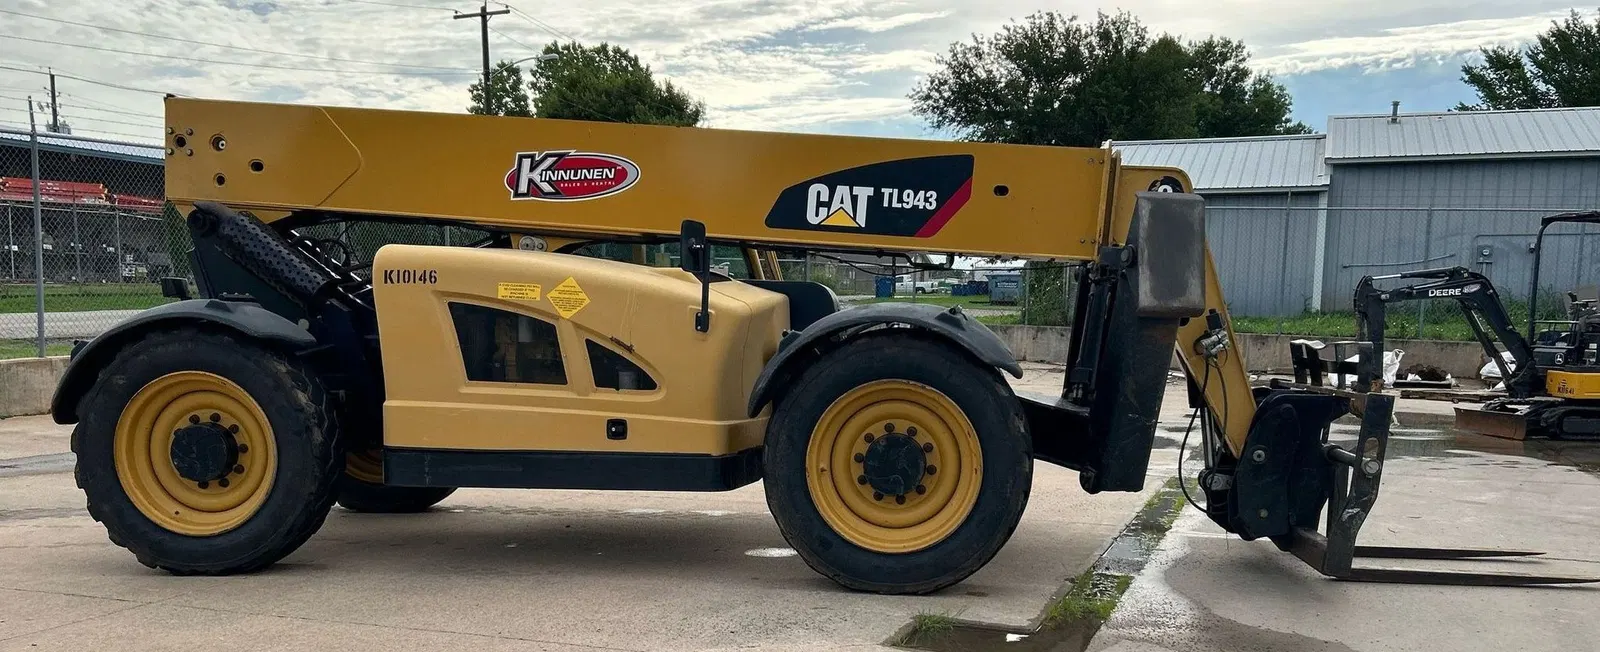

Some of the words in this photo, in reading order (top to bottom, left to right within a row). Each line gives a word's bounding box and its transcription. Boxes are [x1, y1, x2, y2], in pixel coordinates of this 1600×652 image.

[517, 157, 615, 194] KINNUNEN
[806, 183, 874, 228] CAT
[881, 188, 937, 210] TL943
[383, 269, 437, 284] K10146
[1429, 288, 1462, 296] DEERE
